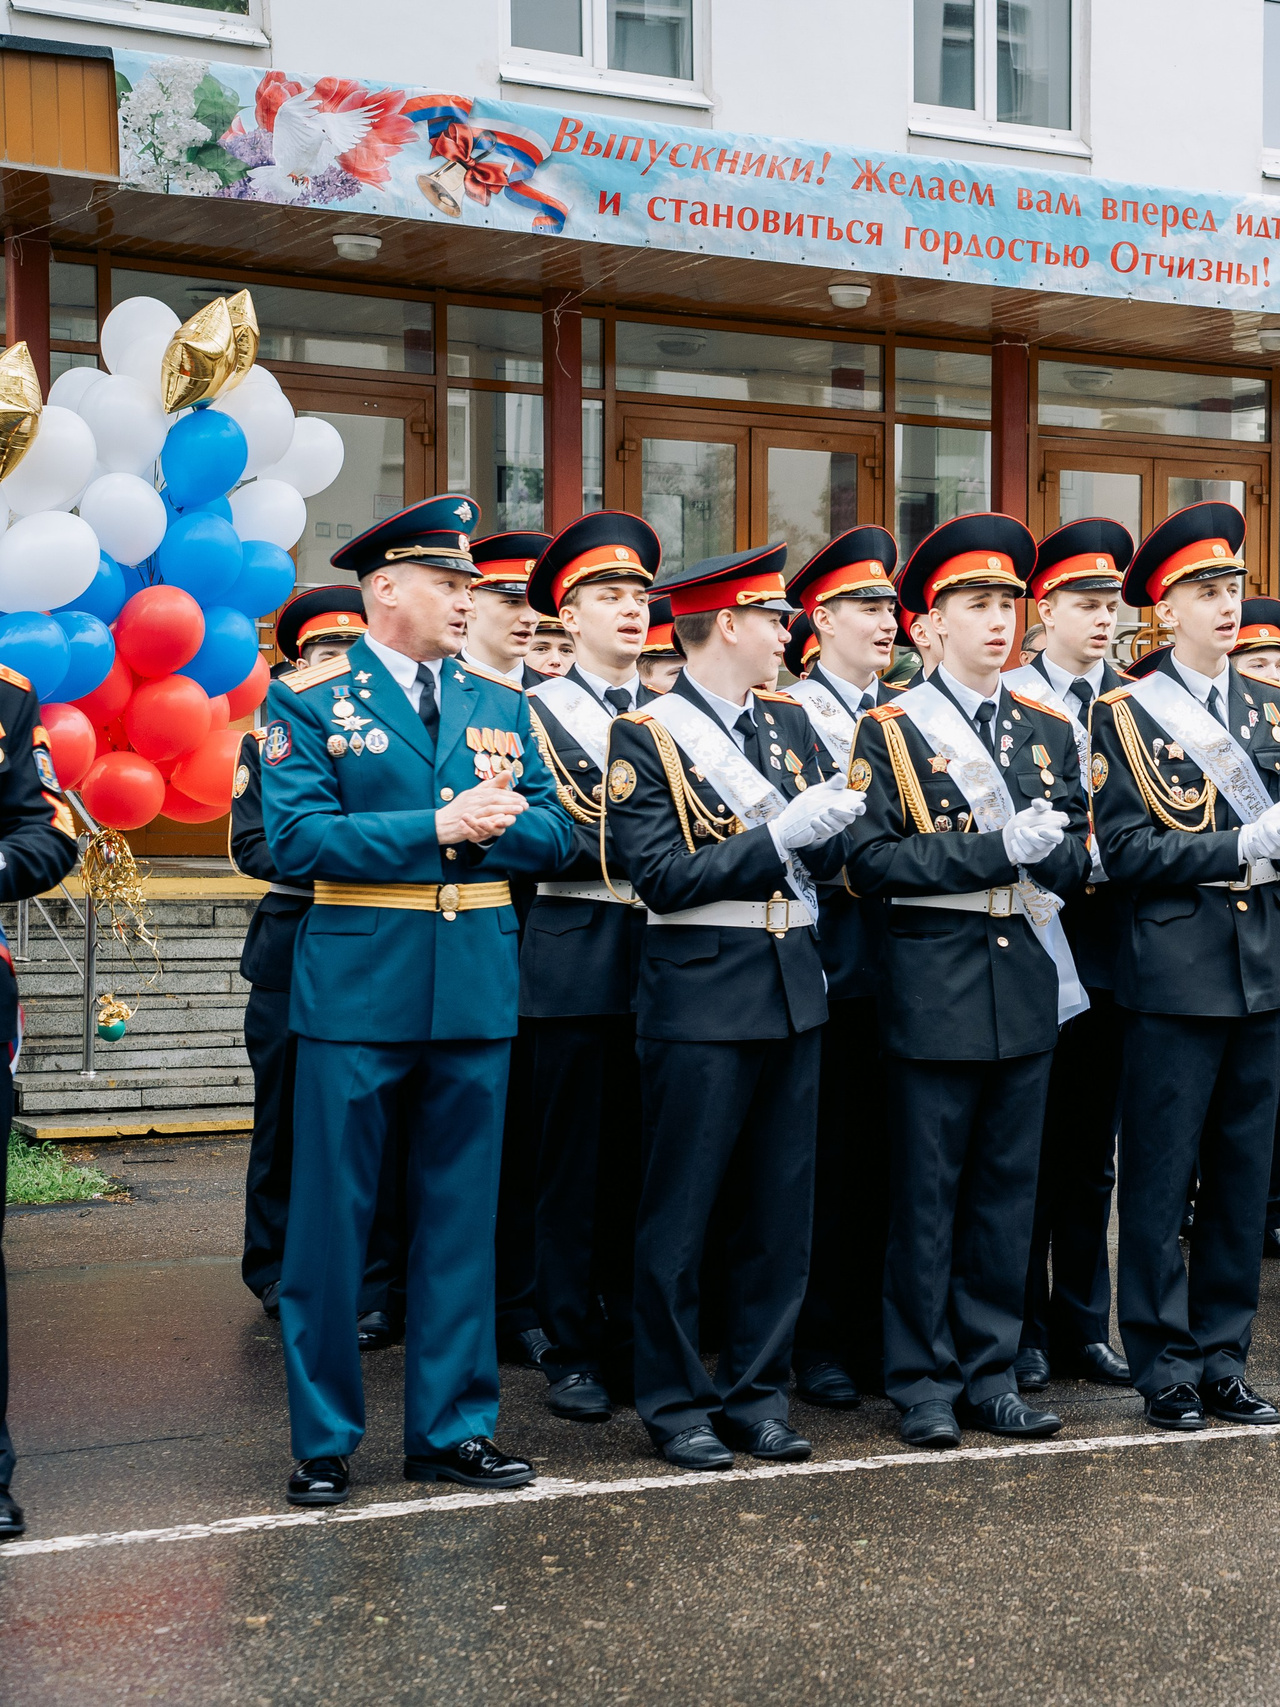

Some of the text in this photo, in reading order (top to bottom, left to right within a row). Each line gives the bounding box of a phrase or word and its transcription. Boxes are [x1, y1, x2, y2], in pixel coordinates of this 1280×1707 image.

[551, 116, 831, 186] Выпускники!
[851, 157, 996, 207] Желаем
[1016, 187, 1082, 217] вам
[1101, 197, 1218, 237] вперед
[598, 190, 1271, 288] и становиться гордостью Отчизны!
